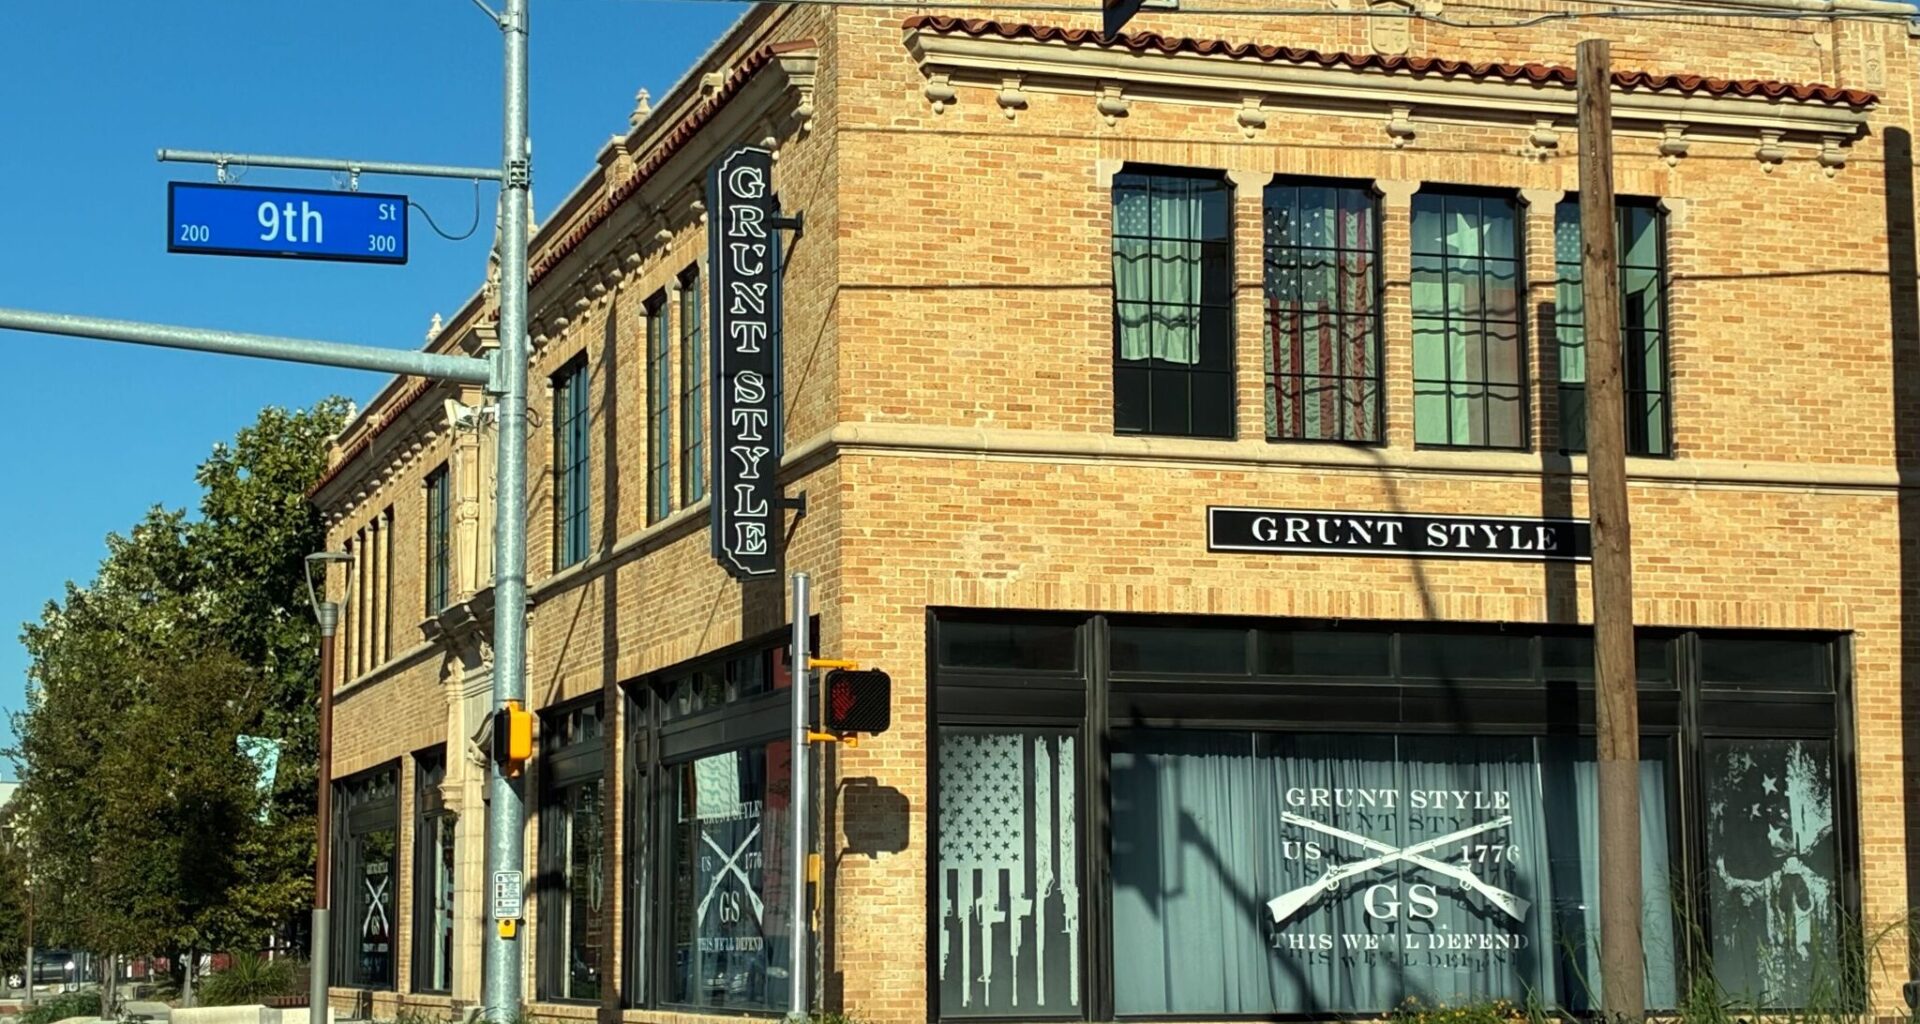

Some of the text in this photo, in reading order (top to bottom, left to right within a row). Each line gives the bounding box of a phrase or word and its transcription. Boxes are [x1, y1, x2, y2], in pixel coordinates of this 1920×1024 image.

[181, 224, 209, 242] 200
[258, 201, 396, 243] 9th St
[368, 235, 396, 252] 300
[728, 166, 769, 556] GRUNT STYLE
[1252, 516, 1557, 550] GRUNT STYLE
[1286, 787, 1510, 809] GRUNT STYLE
[745, 851, 762, 870] 1776
[1282, 841, 1520, 863] US 1776
[720, 891, 740, 922] GS
[1364, 884, 1438, 919] GS
[1270, 933, 1333, 950] THIS
[1429, 933, 1529, 949] DEFEND
